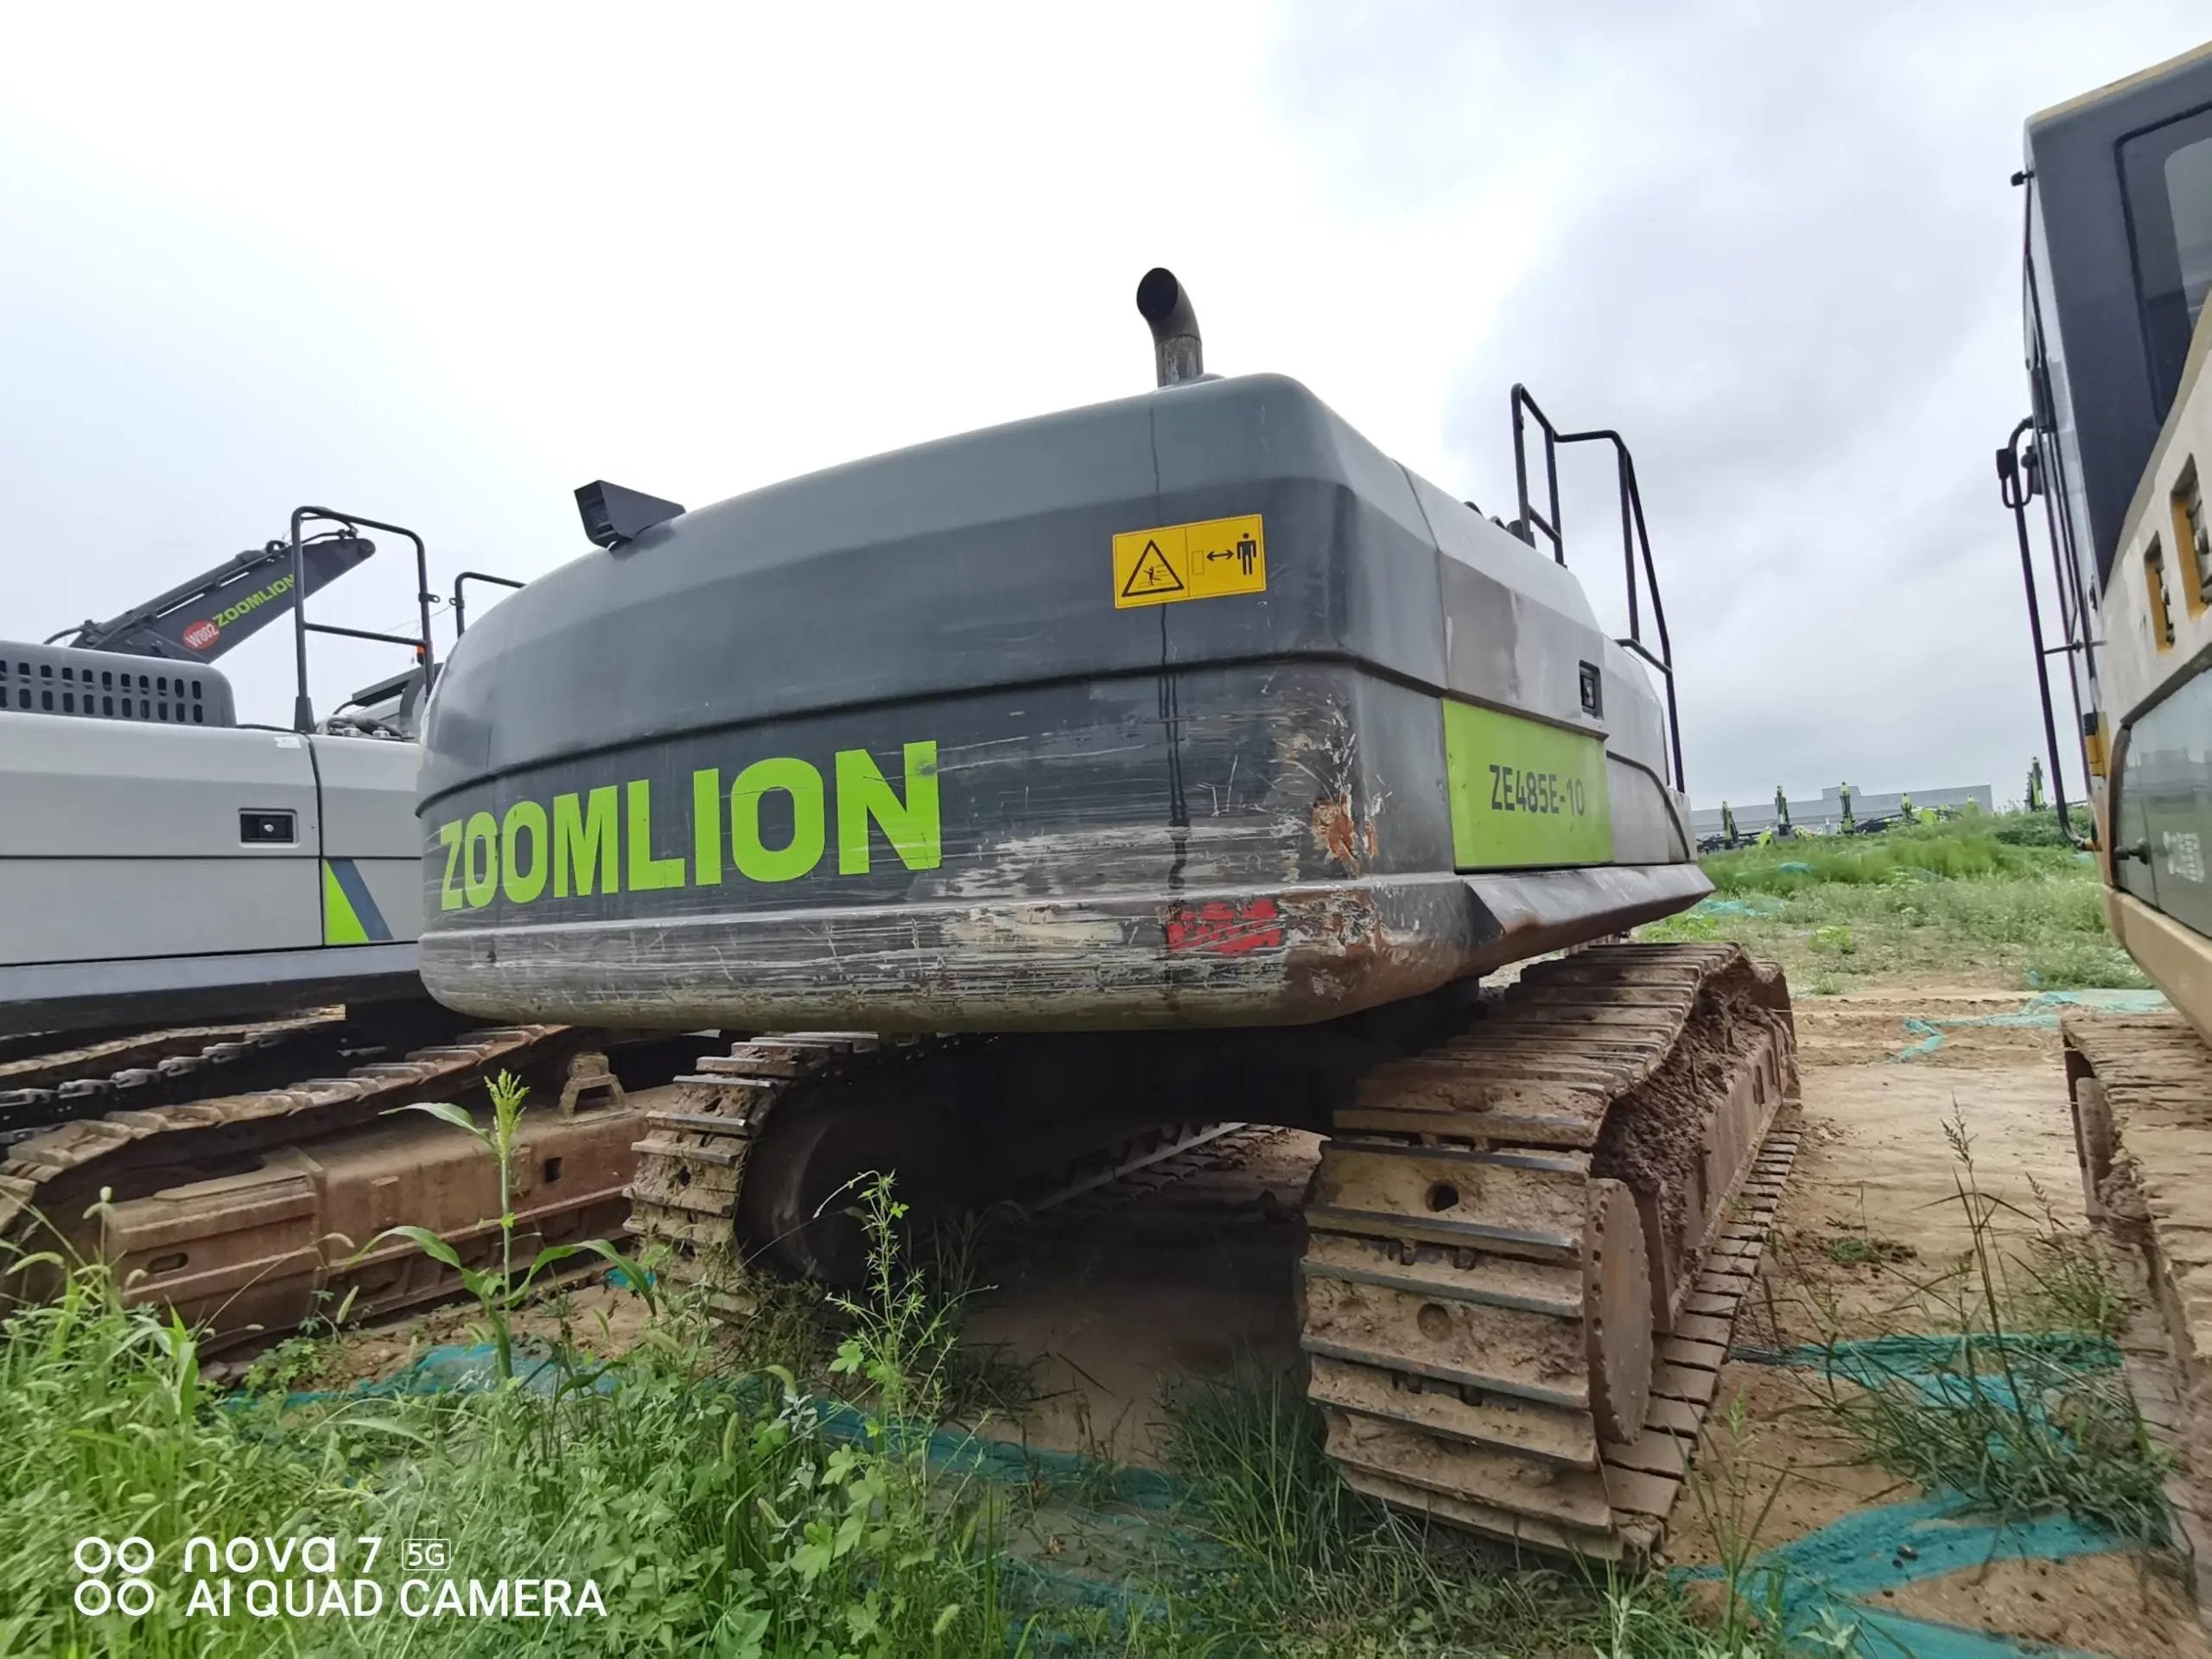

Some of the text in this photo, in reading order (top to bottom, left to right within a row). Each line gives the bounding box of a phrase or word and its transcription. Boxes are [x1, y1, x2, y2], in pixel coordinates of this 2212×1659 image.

[212, 573, 295, 627] ZOOMLION
[1489, 764, 1585, 817] ZE485E-10
[439, 741, 942, 912] ZOOMLION
